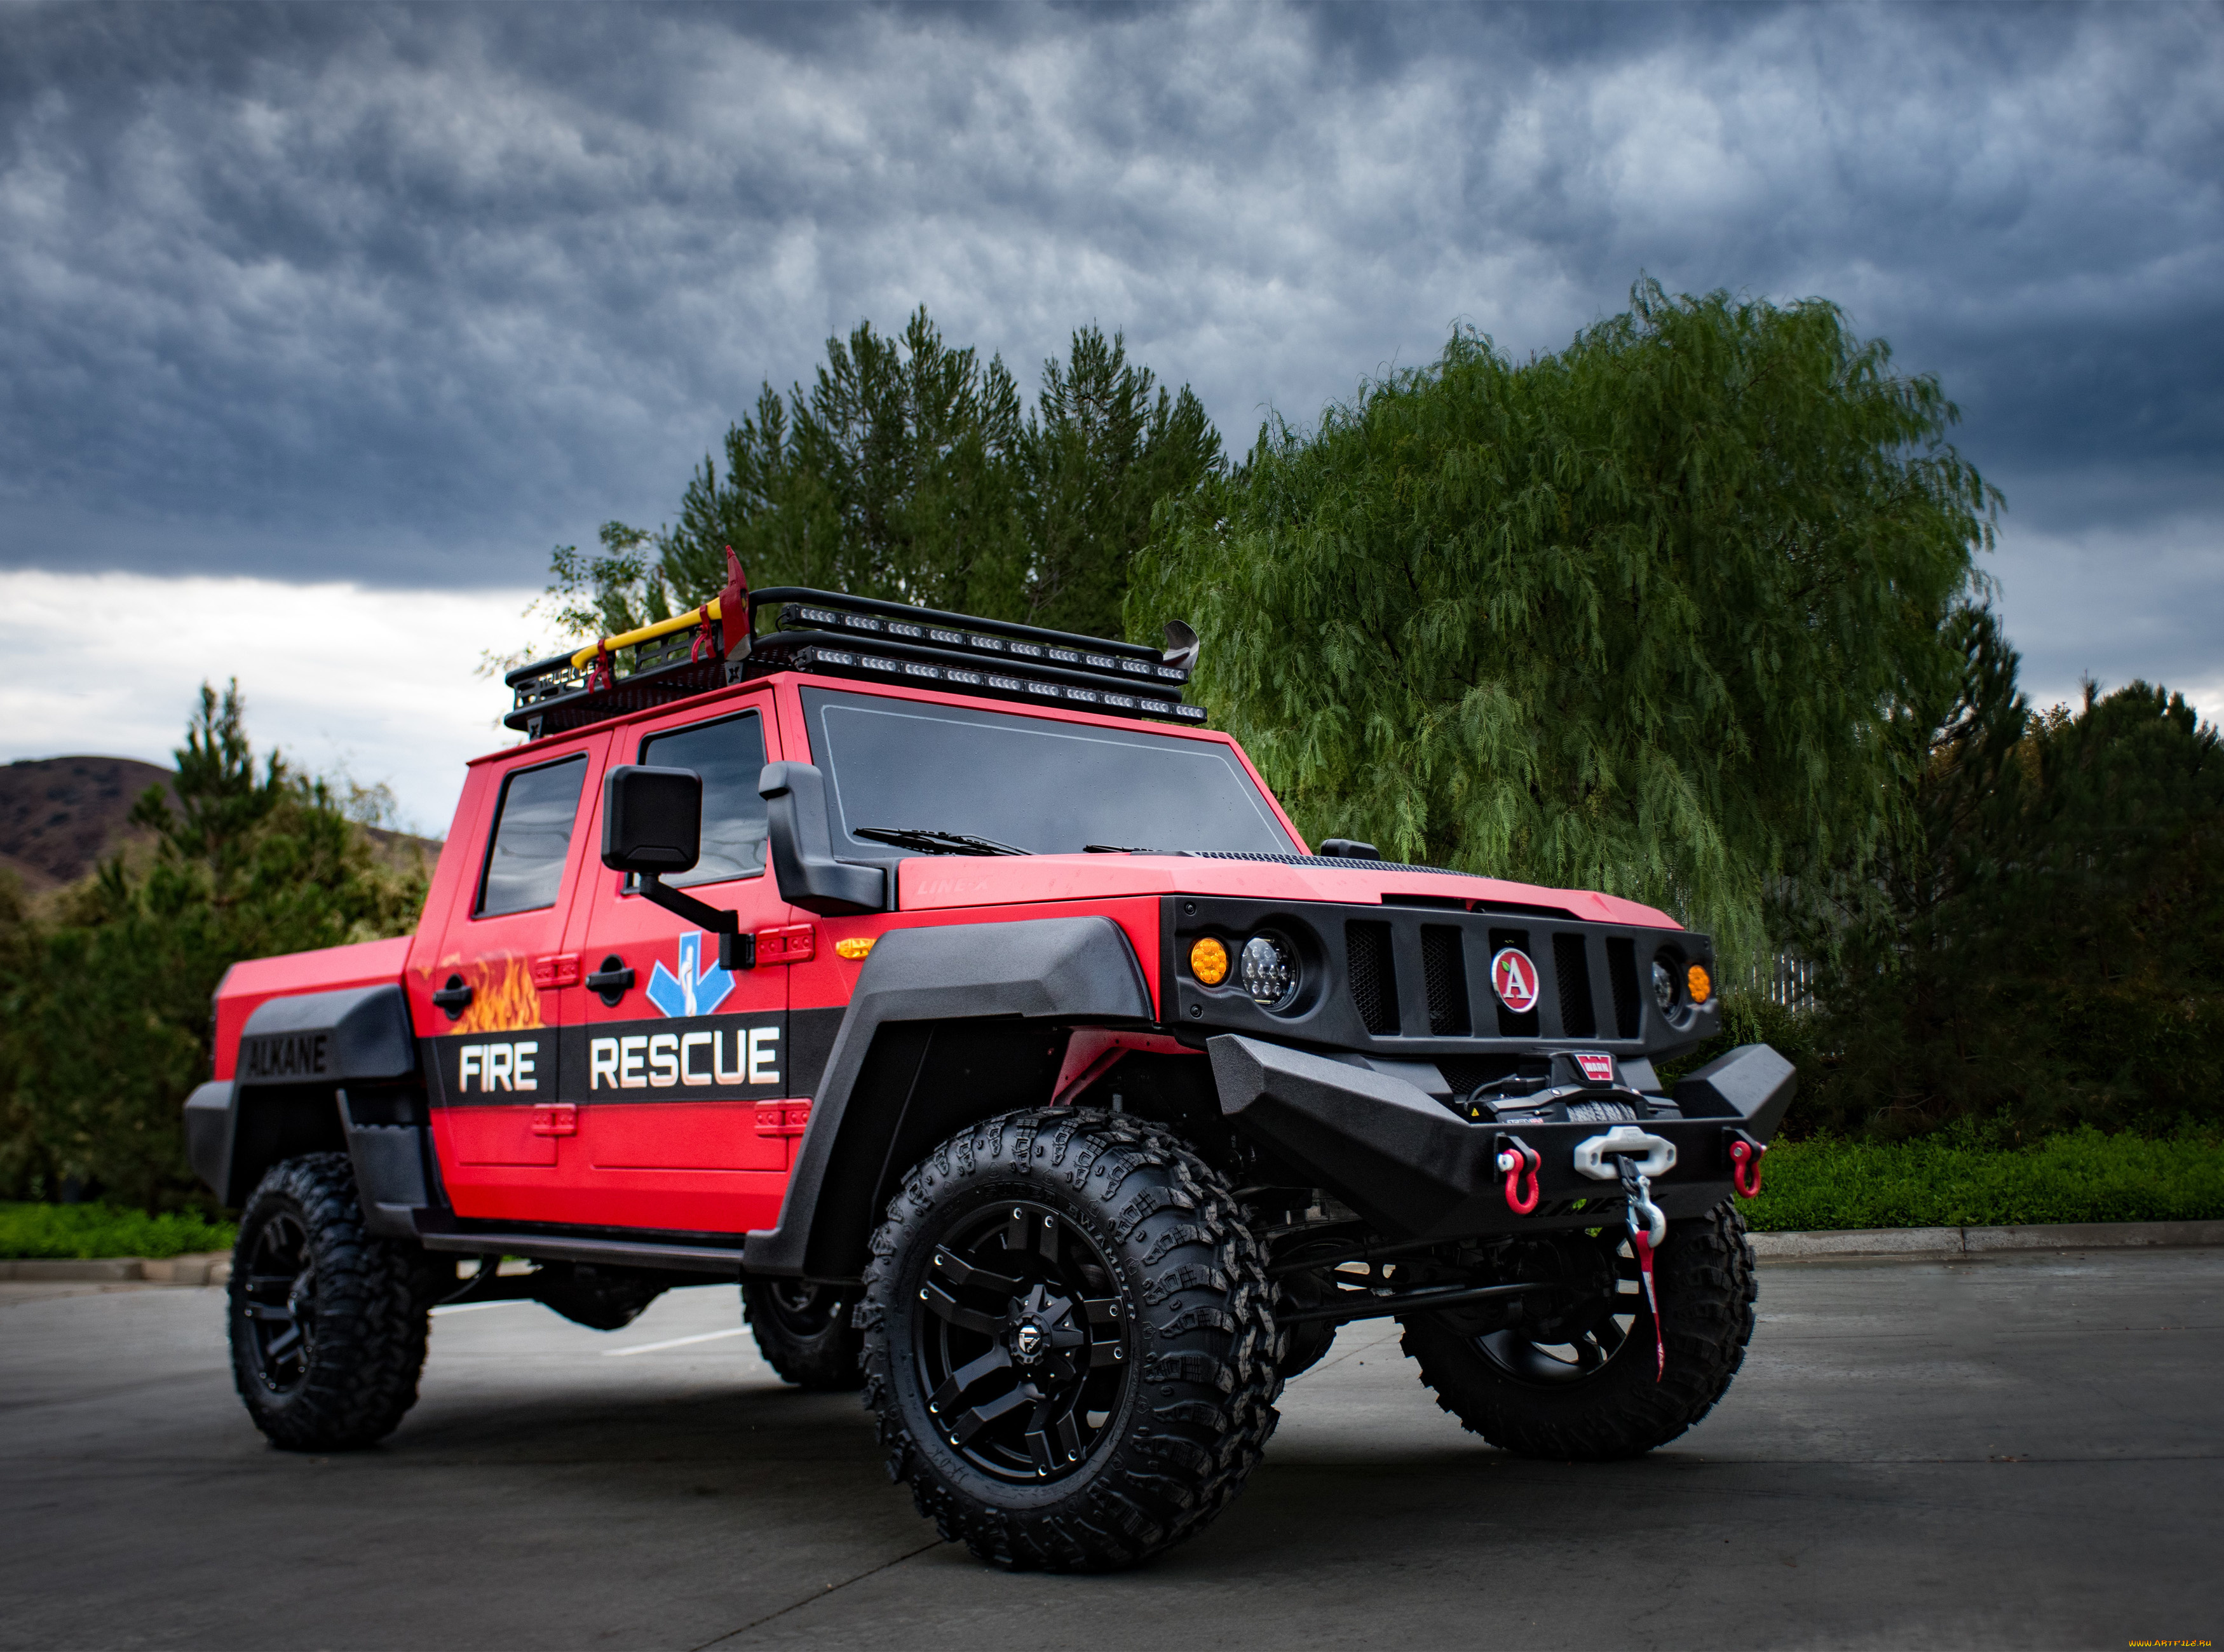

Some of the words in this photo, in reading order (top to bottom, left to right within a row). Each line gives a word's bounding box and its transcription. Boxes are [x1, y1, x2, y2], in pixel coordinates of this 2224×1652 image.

[538, 667, 576, 688] TRUCK
[917, 874, 994, 895] LINE-X
[1503, 957, 1533, 999] A
[247, 1035, 328, 1076] ALKANE
[459, 1041, 539, 1093] FIRE
[590, 1027, 780, 1090] RESCUE
[1583, 1062, 1610, 1073] WARN
[1523, 1194, 1669, 1219] LINE-
